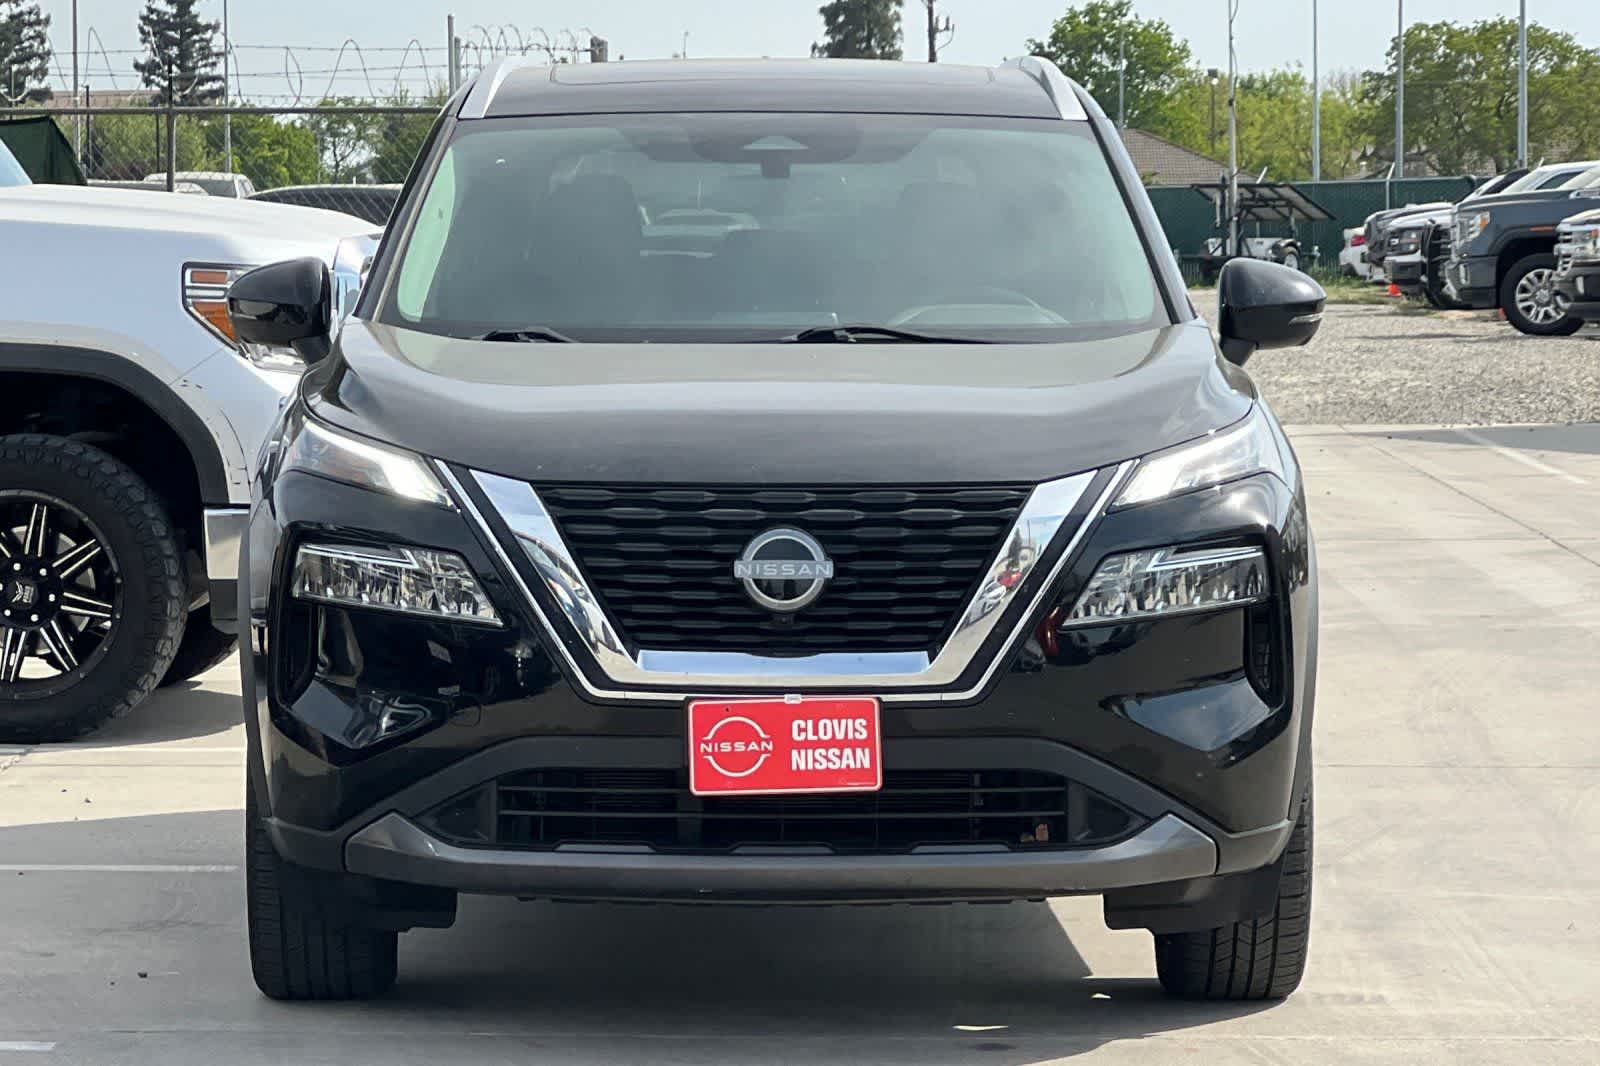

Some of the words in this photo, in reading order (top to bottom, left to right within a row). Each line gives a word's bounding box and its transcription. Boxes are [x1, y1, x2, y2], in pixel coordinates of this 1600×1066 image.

[737, 563, 830, 576] NISSAN
[791, 718, 868, 741] CLOVIS
[700, 740, 774, 753] NISSAN
[791, 747, 871, 771] NISSAN
